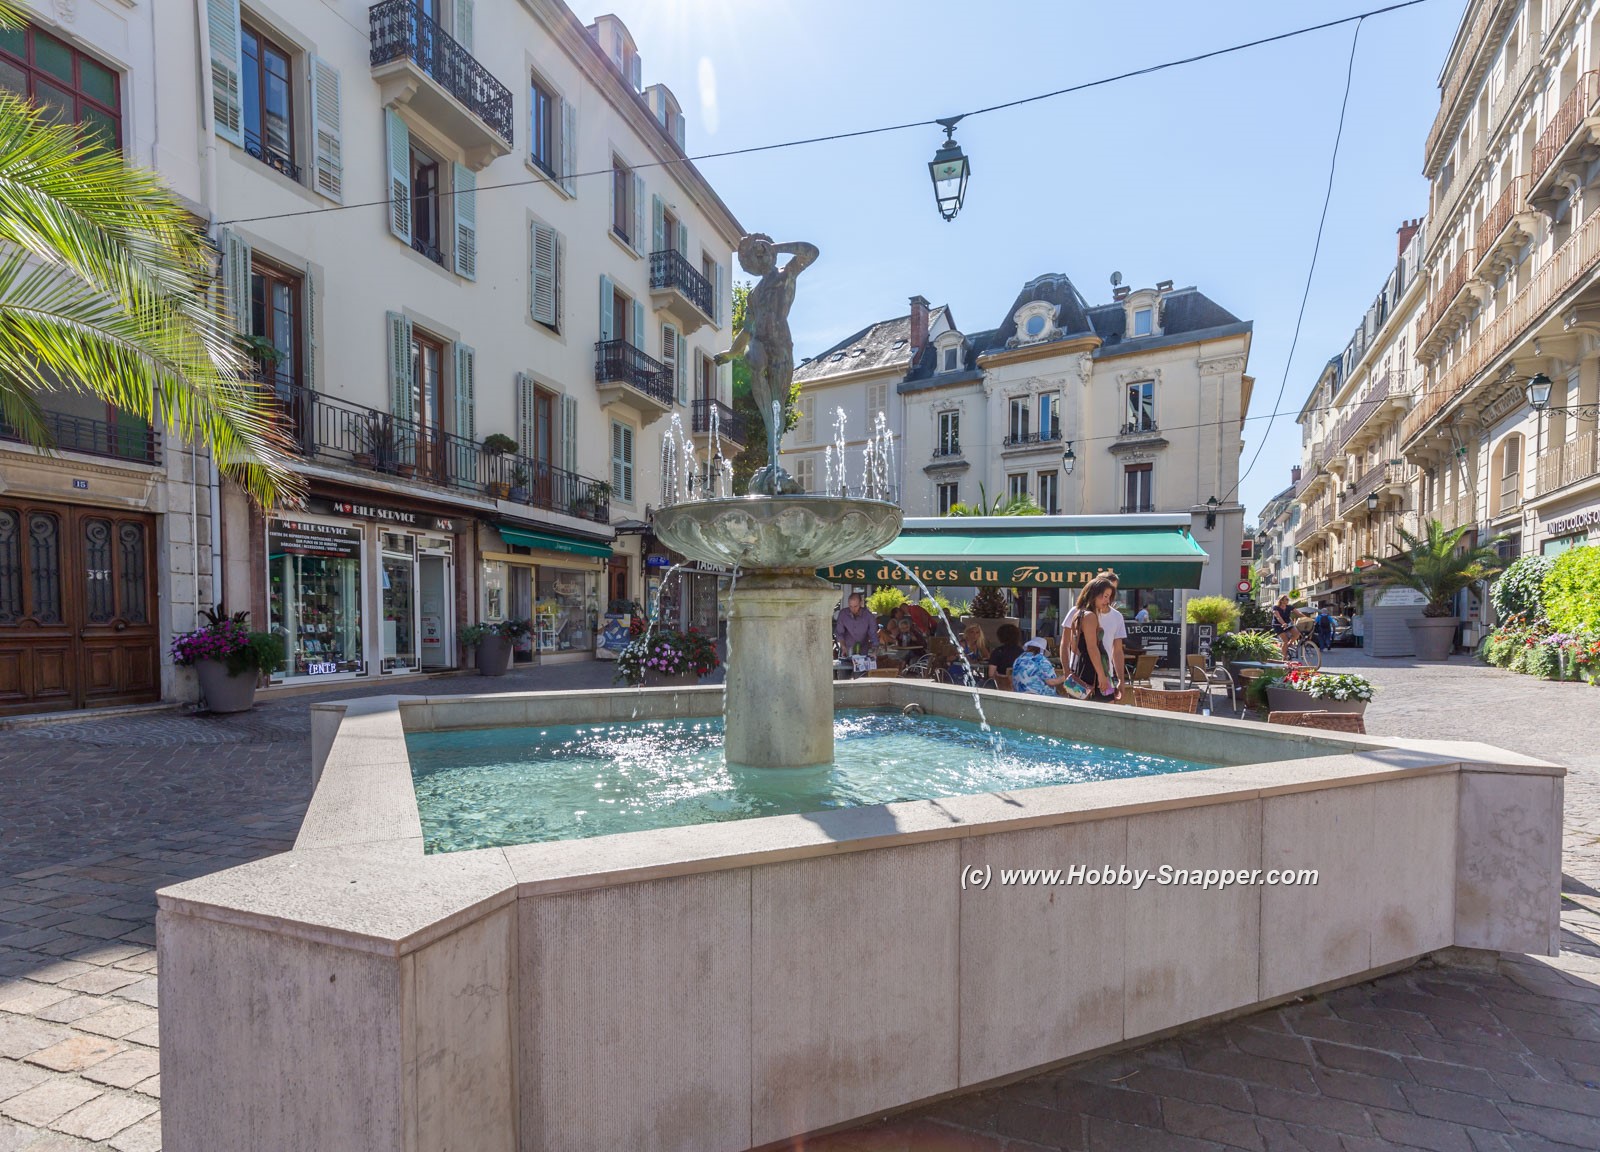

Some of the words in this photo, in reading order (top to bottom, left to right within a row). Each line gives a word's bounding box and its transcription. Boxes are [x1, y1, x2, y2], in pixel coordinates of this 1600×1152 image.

[76, 480, 86, 489] 15
[377, 508, 416, 523] SERVICE
[1566, 512, 1592, 530] COLORS
[316, 523, 349, 536] SERVICE
[827, 565, 866, 579] Les
[969, 567, 998, 582] du
[1011, 565, 1114, 584] Fourn
